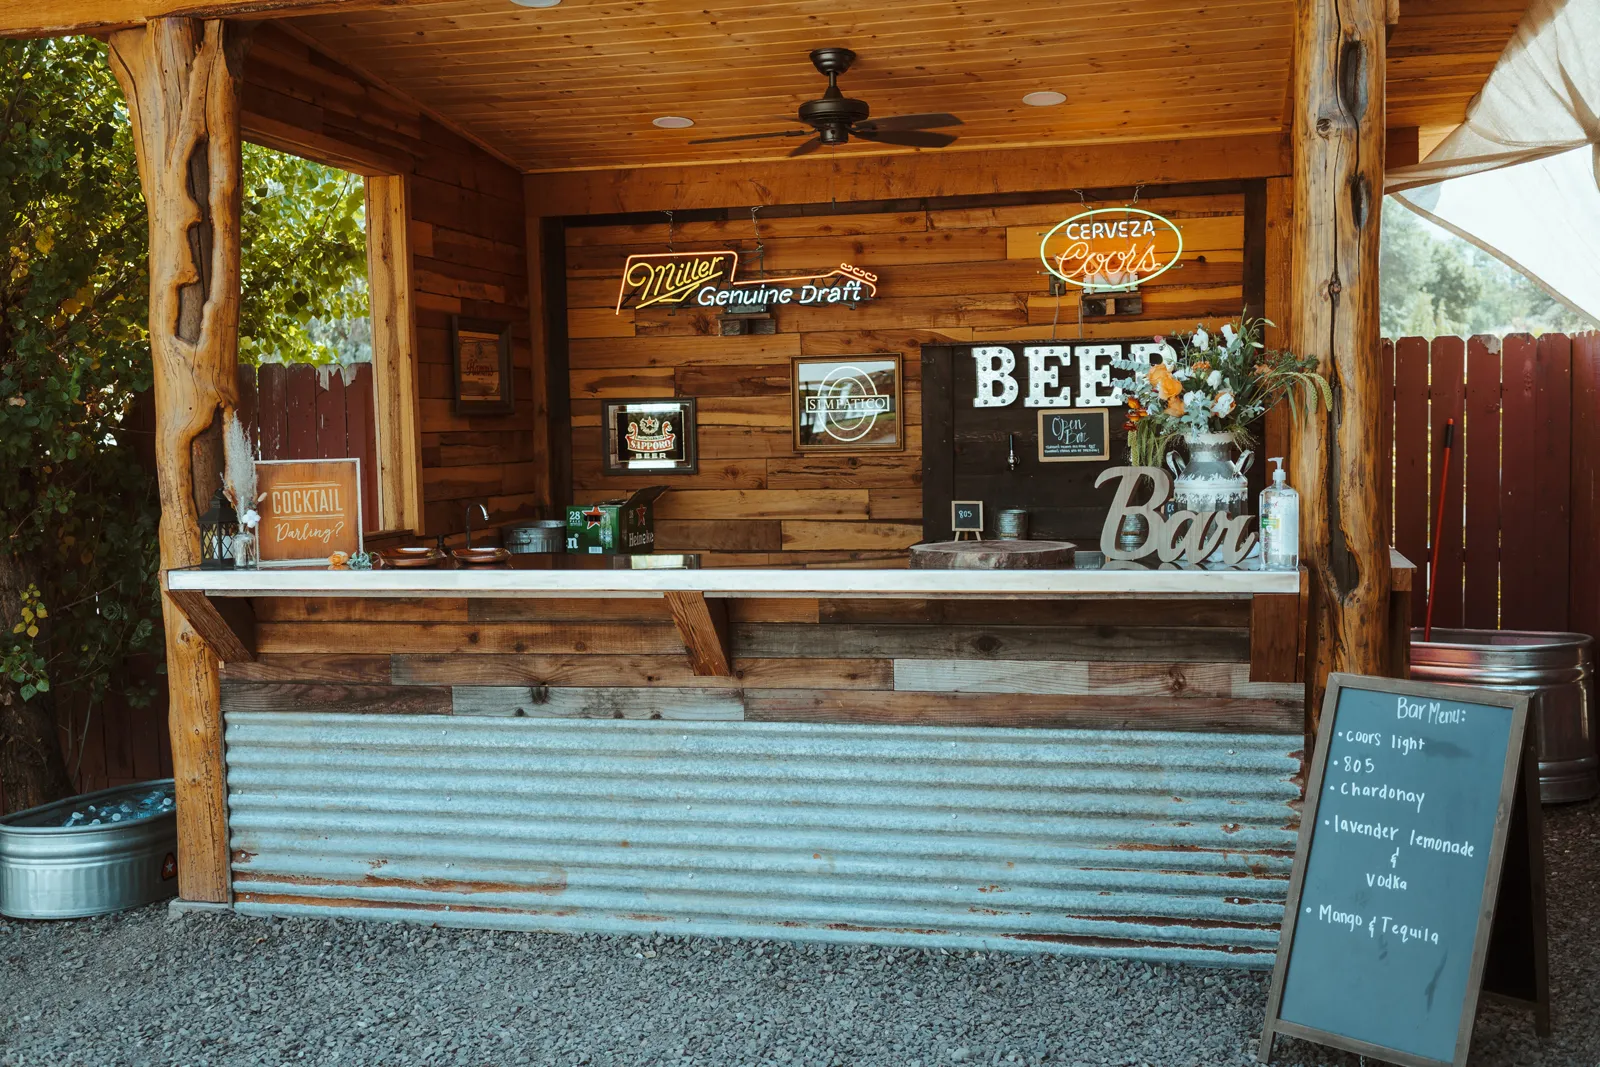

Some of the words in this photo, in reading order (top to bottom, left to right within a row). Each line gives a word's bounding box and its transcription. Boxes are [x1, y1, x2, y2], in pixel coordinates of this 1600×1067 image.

[1066, 220, 1156, 240] CERVEZA
[1057, 241, 1161, 278] Coors
[627, 256, 724, 300] Miller
[697, 284, 793, 306] Genuine
[799, 280, 861, 303] Draft
[809, 397, 887, 411] SIMPATICO
[1051, 415, 1087, 441] Open
[630, 440, 671, 451] SAPPORO
[271, 488, 344, 514] COCKTAIL
[569, 511, 581, 520] 28
[958, 510, 972, 519] 805
[1094, 465, 1260, 565] Bar
[274, 521, 345, 544] Darling?
[1397, 697, 1426, 719] Bar
[1428, 702, 1466, 724] Menu:
[1391, 734, 1426, 756] light
[1343, 755, 1375, 773] 805
[1335, 815, 1399, 841] lavender
[1410, 829, 1475, 857] lemonade
[1390, 847, 1400, 868] &
[1319, 904, 1363, 932] Mango
[1368, 916, 1377, 938] &
[1381, 916, 1439, 945] Tequila
